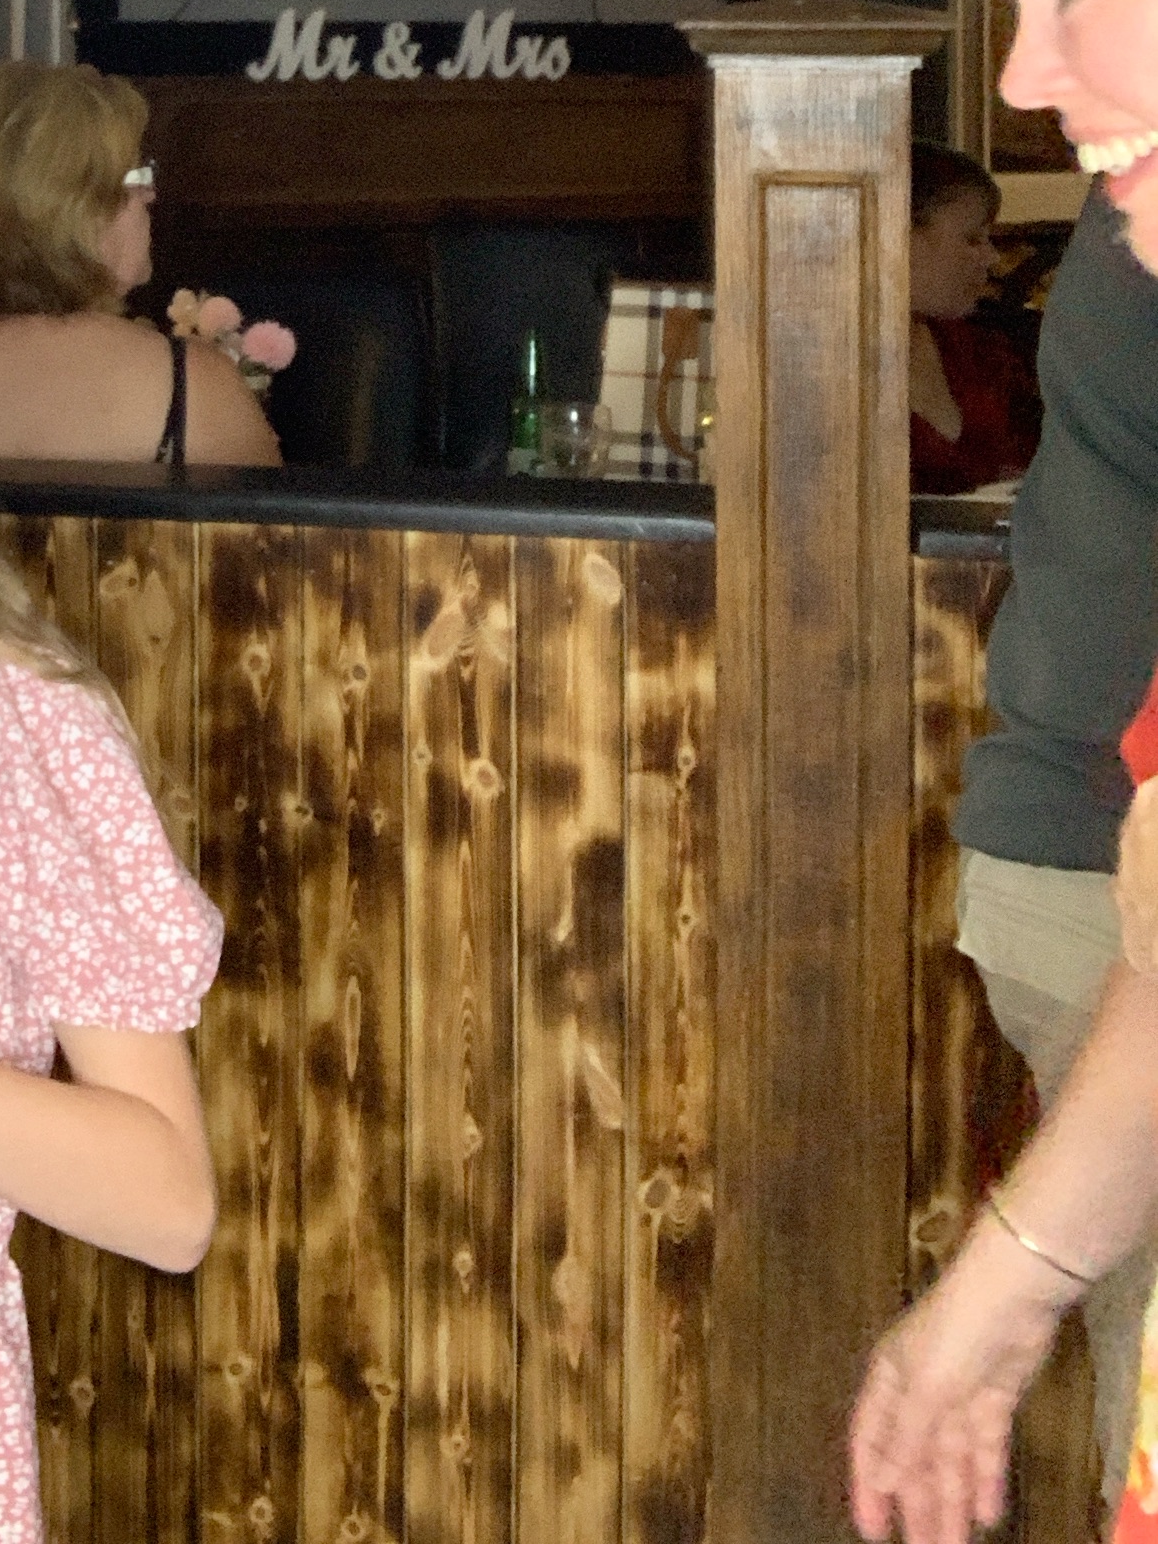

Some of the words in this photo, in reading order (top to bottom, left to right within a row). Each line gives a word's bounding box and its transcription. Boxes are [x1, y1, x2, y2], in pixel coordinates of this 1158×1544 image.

[246, 9, 360, 82] Mr
[373, 21, 422, 80] &
[437, 9, 571, 82] Mrs
